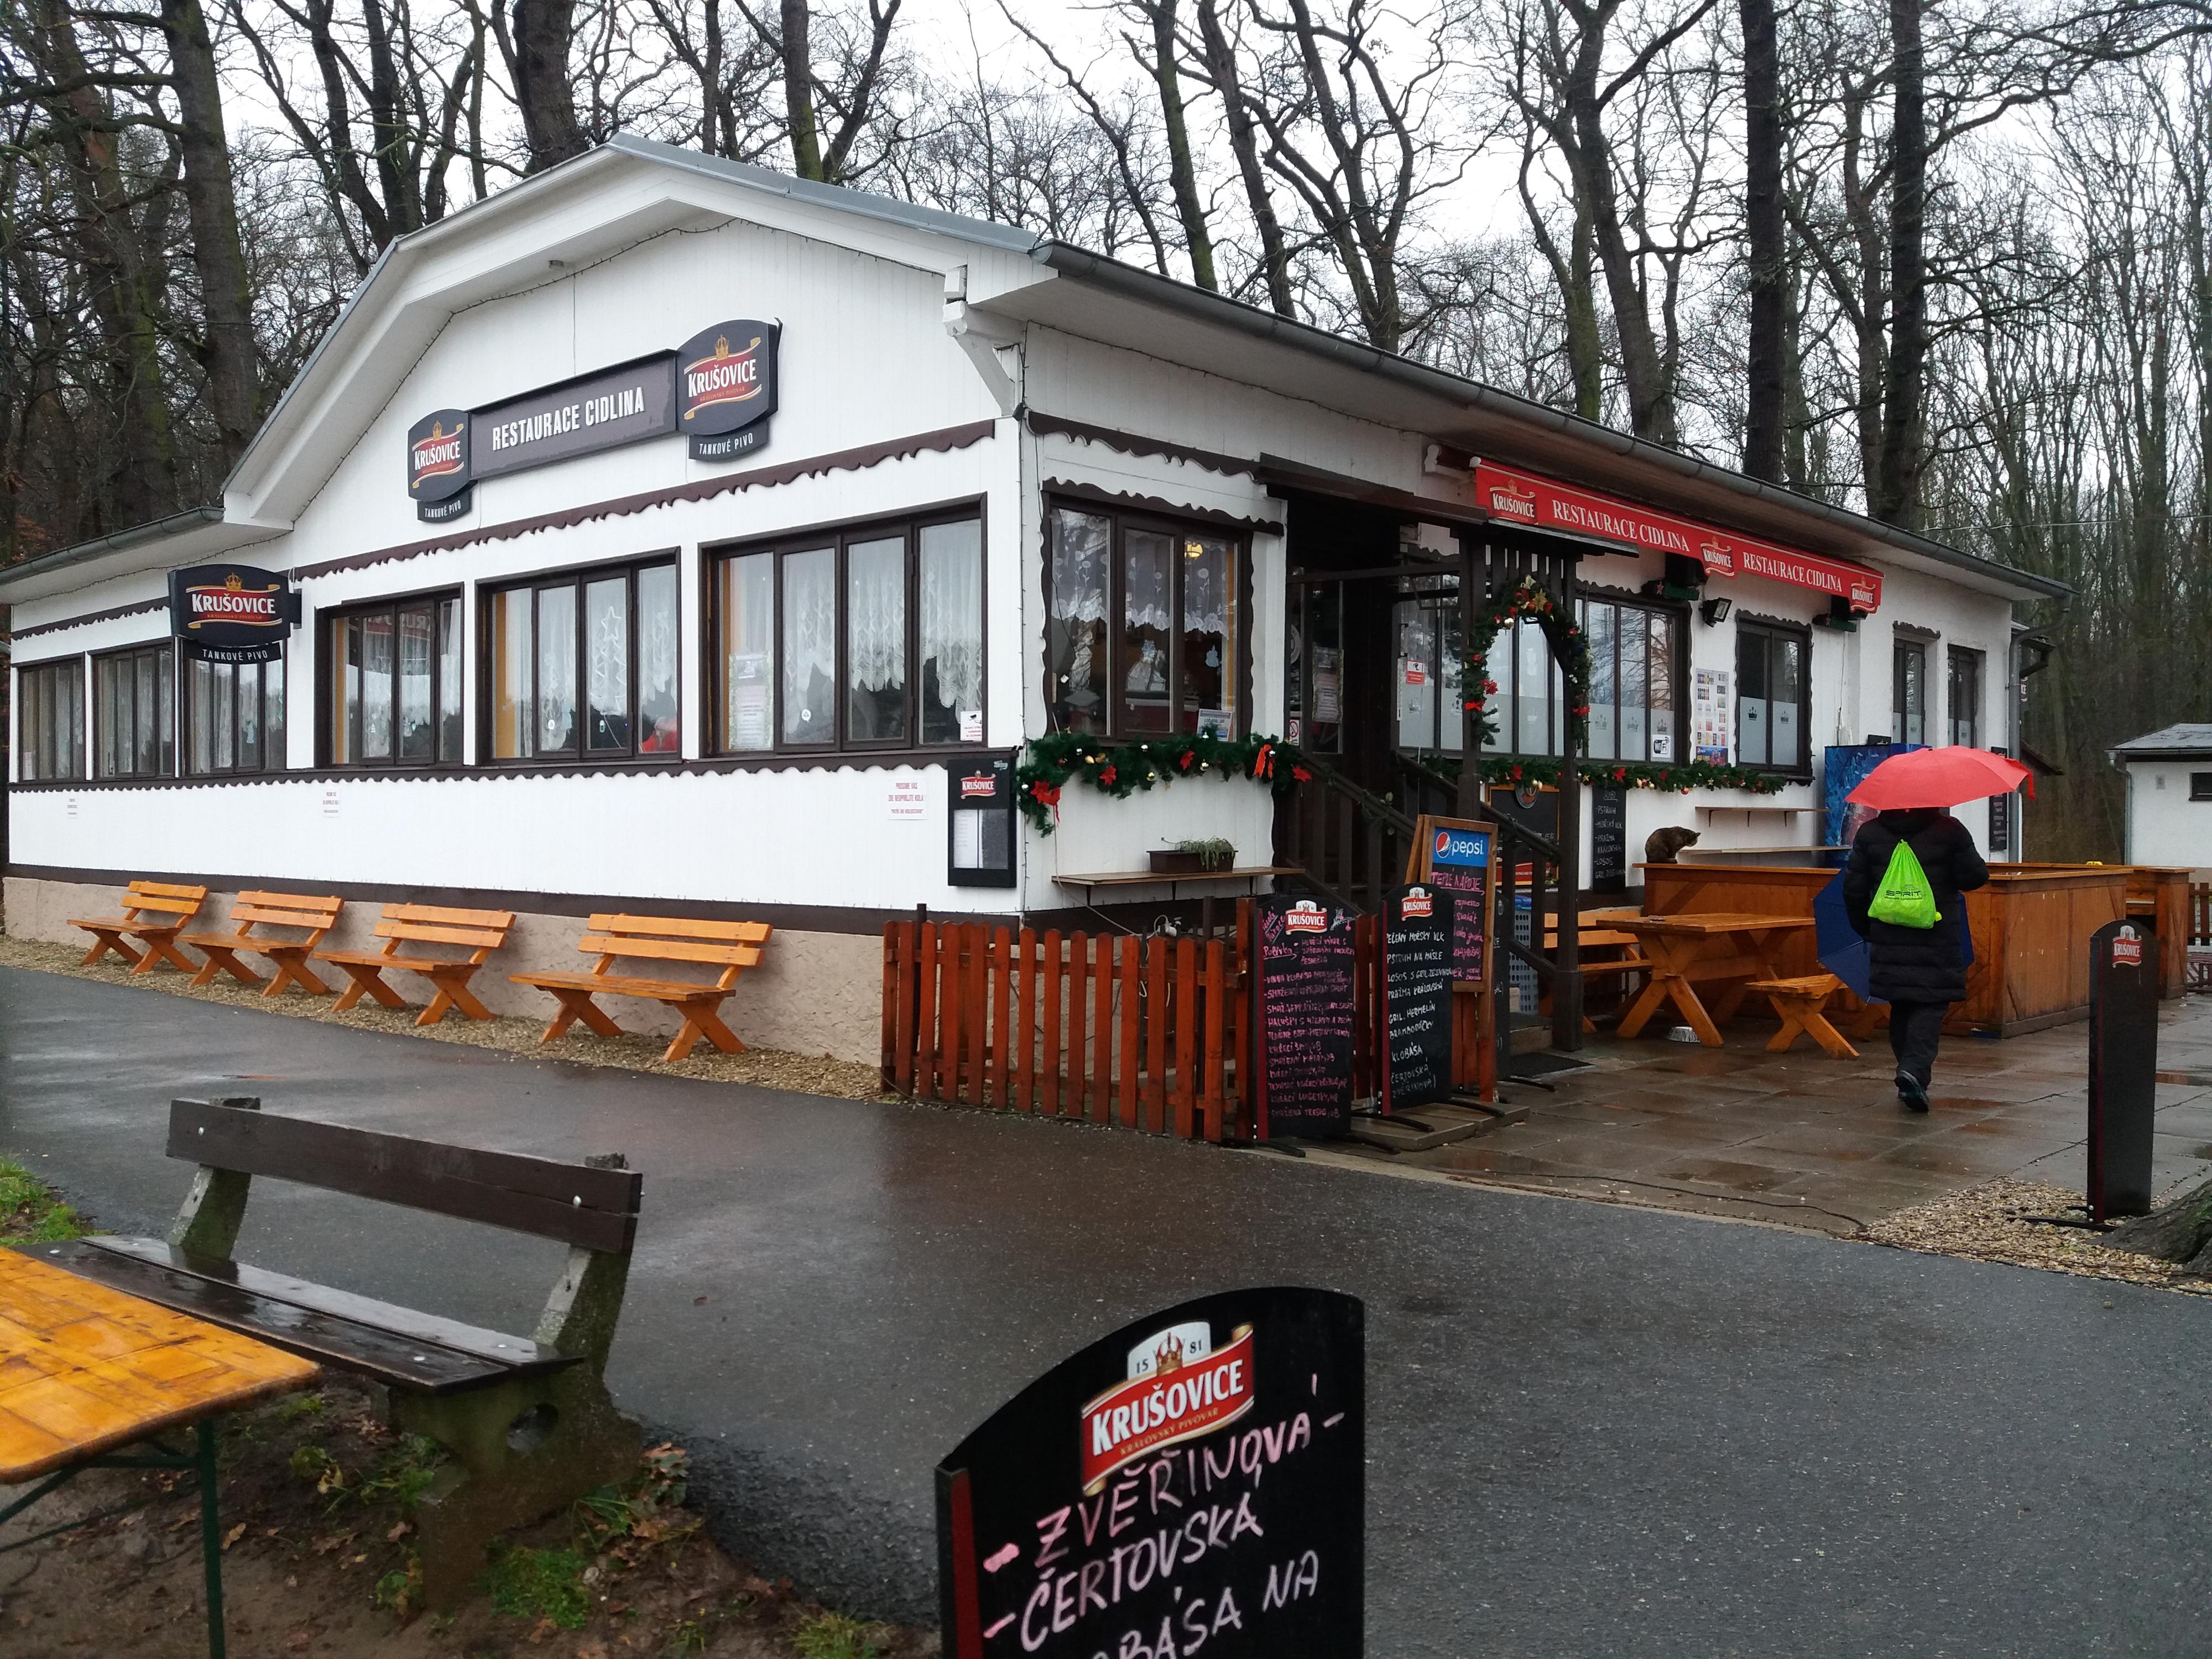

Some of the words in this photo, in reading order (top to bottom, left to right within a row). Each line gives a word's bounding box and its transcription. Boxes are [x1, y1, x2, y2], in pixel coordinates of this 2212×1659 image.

[688, 359, 757, 398] KRUŠOVICE
[492, 404, 580, 451] RESTAURACE
[586, 387, 645, 426] CIDLINA
[699, 439, 731, 455] TANKOVÉ
[734, 433, 753, 450] PIVO
[415, 441, 460, 470] KRUŠOVICE
[425, 504, 447, 518] TANKOVÉ
[448, 500, 461, 514] PIVO
[1492, 493, 1535, 518] KRUŠOVICE
[1552, 499, 1637, 540] RESTAURACE
[1639, 524, 1690, 552] CIDLINA
[1703, 547, 1732, 568] KRUŠOVICE
[1743, 551, 1805, 582] RESTAURACE
[1806, 568, 1842, 592] CIDLINA
[192, 593, 276, 614] KRUŠOVICE
[1852, 587, 1874, 604] KRUŠOVICE
[202, 649, 243, 661] TANKOVÉ
[247, 650, 268, 660] PIVO
[962, 780, 994, 791] KRUŠOVICE
[1452, 840, 1484, 857] pepsi
[1403, 900, 1431, 912] KRUŠOVICE
[1288, 914, 1324, 926] KRUŠOVICE
[1433, 932, 1445, 942] VLK
[1413, 952, 1423, 962] NA
[2114, 942, 2141, 957] KRUŠOVICE
[1387, 972, 1407, 983] LOSOS
[1410, 972, 1415, 980] S
[1135, 1358, 1149, 1374] 15
[1190, 1340, 1203, 1354] 81
[1092, 1359, 1244, 1457] KRUŠOVICE
[1178, 1406, 1219, 1441] PIVOVAR
[1020, 1463, 1264, 1652] ČERTOVSKÁ
[1262, 1550, 1319, 1611] NA
